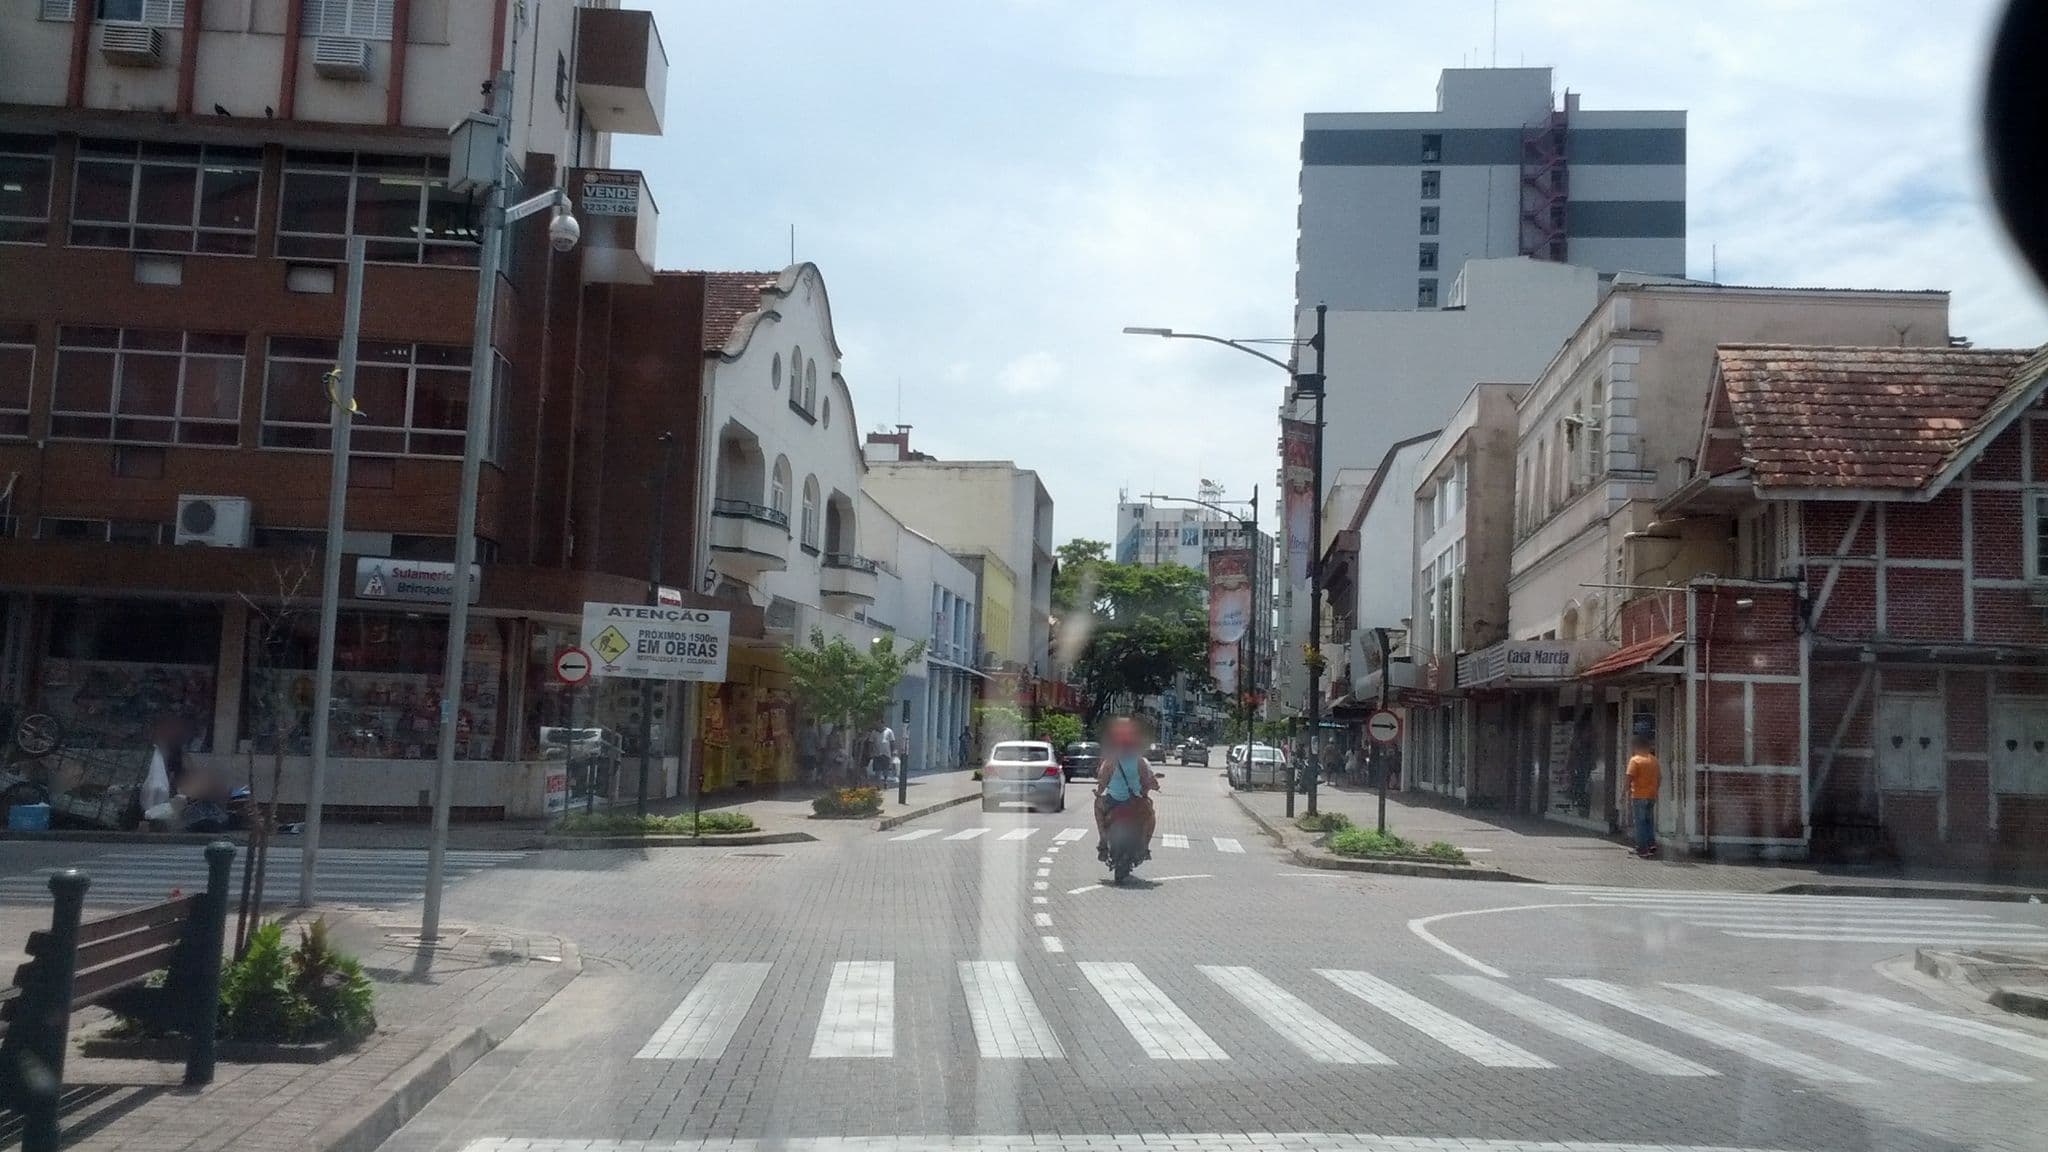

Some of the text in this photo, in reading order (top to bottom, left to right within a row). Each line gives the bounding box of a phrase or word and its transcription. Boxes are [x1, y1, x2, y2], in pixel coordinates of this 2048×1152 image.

[585, 186, 638, 199] VENDE
[391, 567, 475, 582] Sulamerica
[608, 607, 710, 622] ATENÇÃO
[690, 633, 718, 643] 1500m
[637, 639, 718, 657] EM OBRAS
[1507, 649, 1531, 664] Casa
